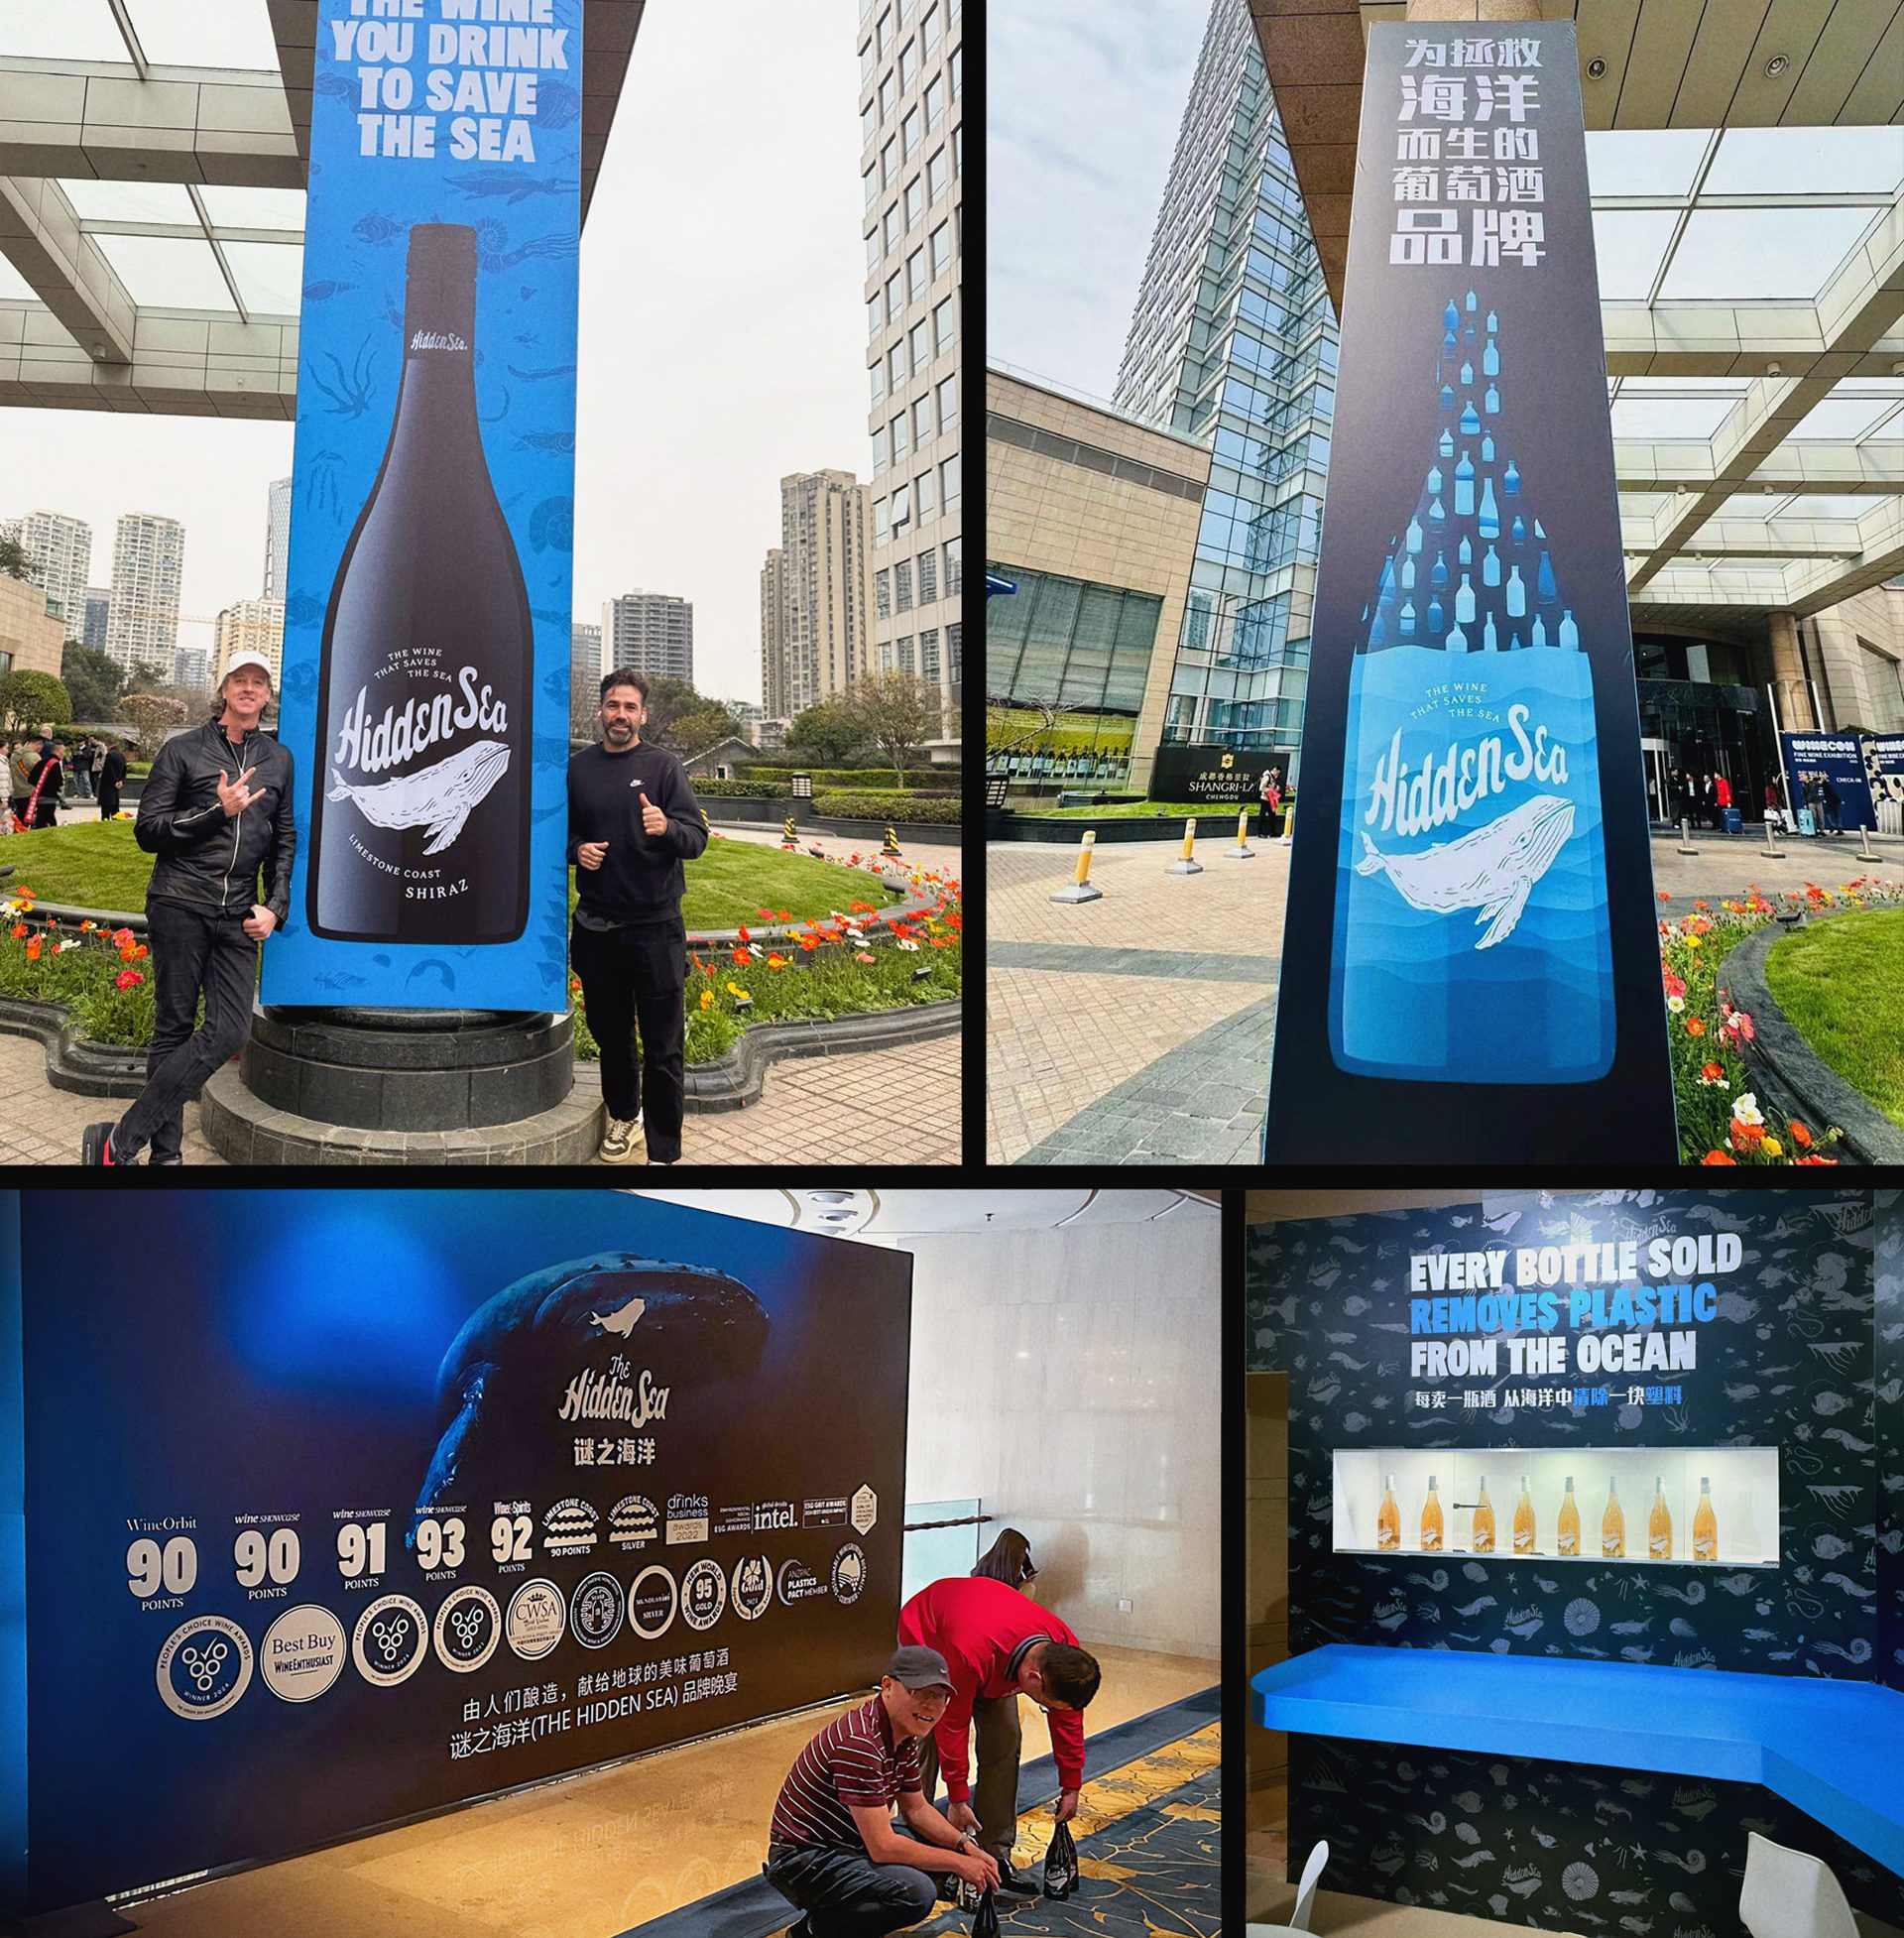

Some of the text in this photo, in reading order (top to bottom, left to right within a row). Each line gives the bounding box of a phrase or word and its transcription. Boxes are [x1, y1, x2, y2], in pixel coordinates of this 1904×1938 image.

[331, 20, 568, 69] YOU DRINK
[1404, 38, 1543, 67] 为拯救
[357, 66, 537, 115] TO SAVE
[1397, 74, 1540, 122] 海洋
[357, 114, 536, 163] THE SEA
[1396, 127, 1539, 160] 而生的
[1392, 165, 1544, 202] 葡萄酒
[1389, 208, 1546, 266] 品牌
[388, 648, 442, 661] THE WINE
[374, 659, 436, 679] THAT SAVES
[433, 669, 452, 682] SEA
[1425, 682, 1488, 698] THE WINE
[1410, 695, 1482, 720] THAT SAVES
[1449, 708, 1499, 723] THE SEA
[348, 833, 441, 879] LIMESTONE COAST
[405, 878, 469, 900] SHIRAZ
[1411, 1233, 1742, 1292] EVERY BOTTLE SOLD
[1411, 1282, 1717, 1334] REMOVES PLASTIC
[1411, 1331, 1697, 1378] FROM THE OCEAN
[609, 1353, 631, 1380] The
[631, 1370, 670, 1428] Sea
[1415, 1385, 1683, 1408] 每卖一瓶酒 从海洋中清除一块塑料
[574, 1438, 655, 1466] 谜之海洋
[416, 1506, 434, 1514] wine
[542, 1498, 600, 1527] LIMESTONE COAST
[608, 1496, 642, 1522] LIMESTONE
[667, 1494, 708, 1510] drinks
[234, 1514, 259, 1524] wine
[333, 1510, 354, 1519] wine
[667, 1509, 708, 1519] business
[676, 1530, 699, 1541] 2022
[727, 1523, 751, 1532] AWARDS
[337, 1522, 386, 1578] 91
[416, 1517, 466, 1570] 93
[491, 1515, 534, 1563] 92
[622, 1540, 646, 1550] SILVER
[234, 1528, 300, 1587] 90
[550, 1545, 591, 1557] 90 POINTS
[127, 1536, 197, 1598] 90
[425, 1570, 456, 1582] POINTS
[499, 1563, 526, 1573] POINTS
[686, 1562, 722, 1585] NEW WORLD
[248, 1587, 288, 1600] POINTS
[344, 1578, 379, 1590] POINTS
[696, 1578, 712, 1600] 95
[787, 1577, 817, 1590] PLASTICS
[787, 1585, 828, 1599] PACT MEMBER
[142, 1598, 184, 1611] POINTS
[373, 1598, 396, 1611] CHOICE
[516, 1601, 557, 1621] CWSA
[684, 1604, 697, 1626] WINE
[698, 1600, 723, 1627] AWARDS
[695, 1602, 713, 1612] GOLD
[182, 1620, 211, 1635] CHOICE
[214, 1620, 233, 1632] WINE
[234, 1631, 251, 1660] AWARDS
[273, 1635, 336, 1654] Best Buy
[184, 1691, 210, 1701] WINNER
[576, 1695, 642, 1728] HIDDEN
[647, 1686, 679, 1711] SEA)
[682, 1671, 738, 1705] 品牌晚宴
